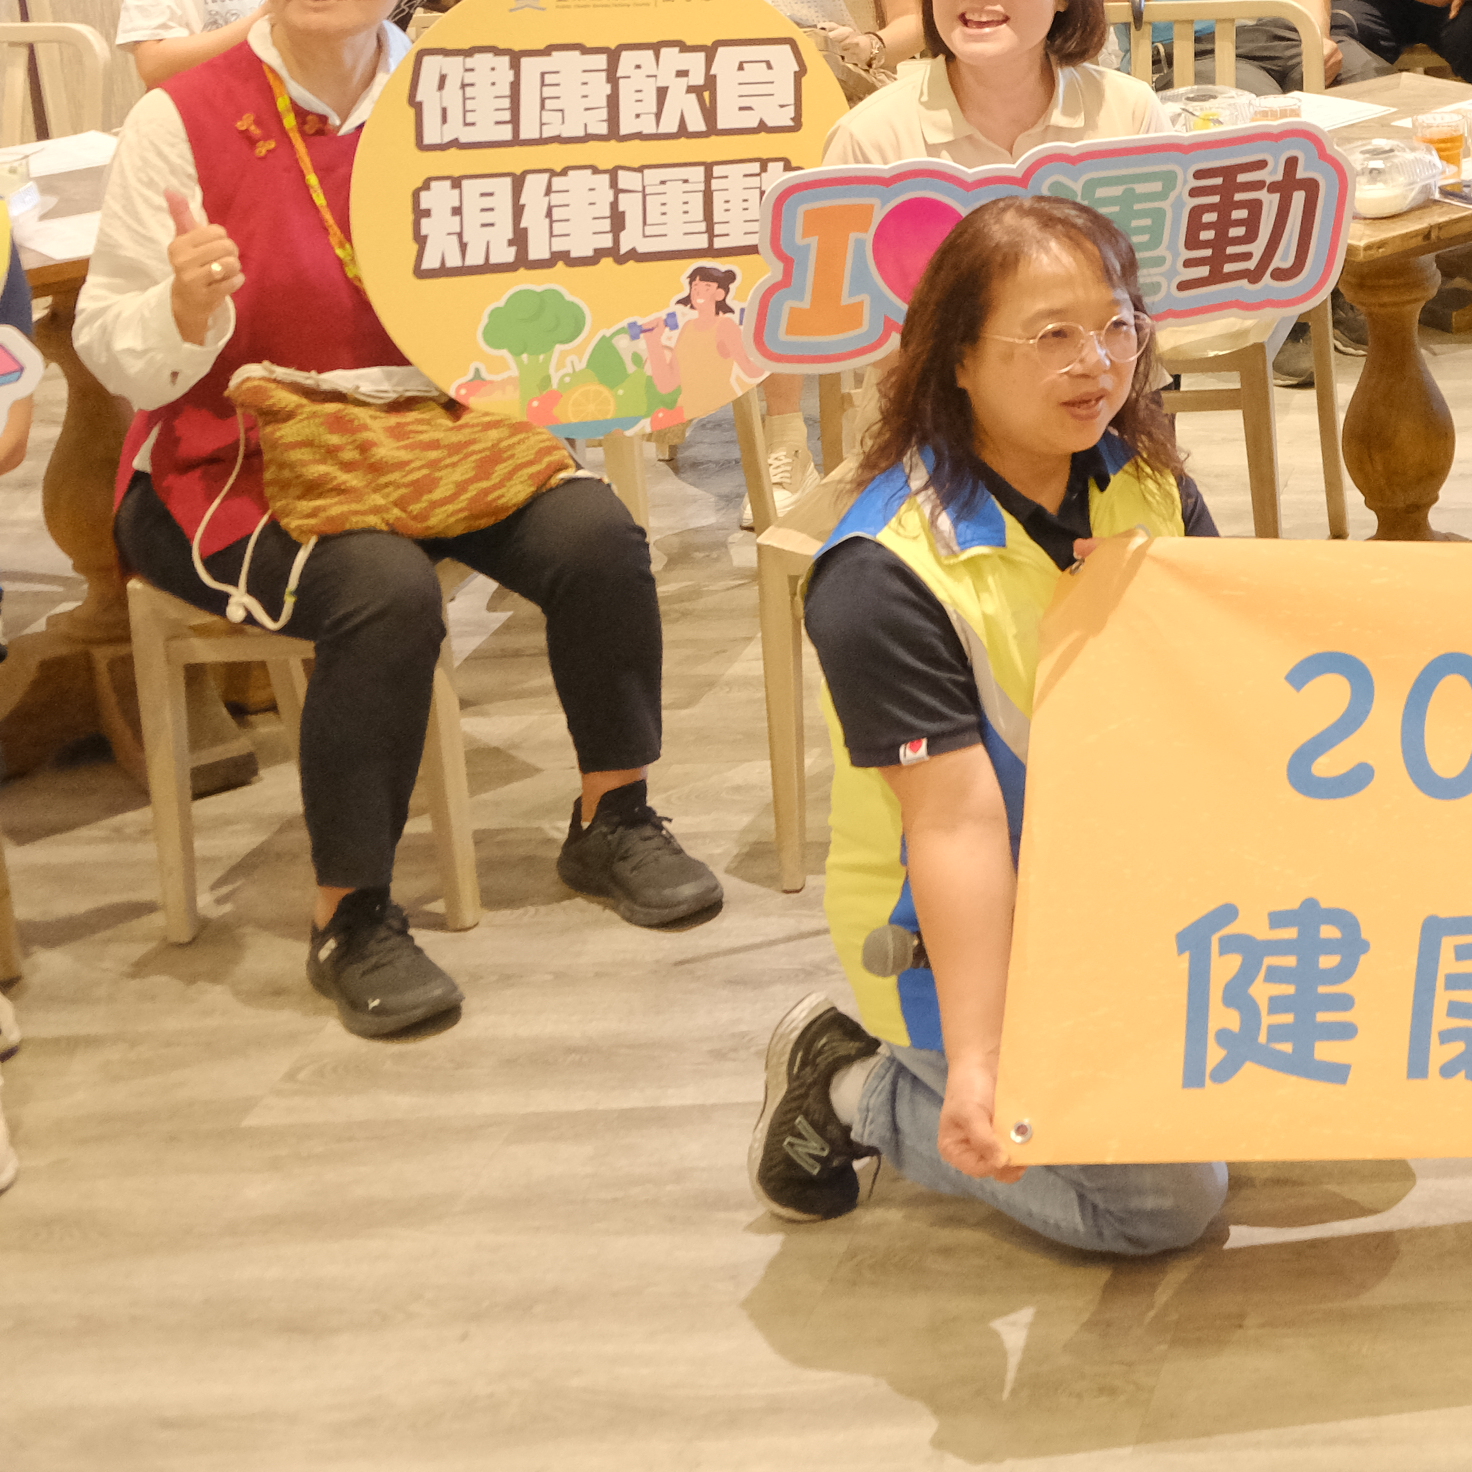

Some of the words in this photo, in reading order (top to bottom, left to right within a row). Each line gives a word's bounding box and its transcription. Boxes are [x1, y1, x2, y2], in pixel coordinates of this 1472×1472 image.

[414, 46, 798, 146] 健康飲食
[416, 162, 786, 274] 規律運動
